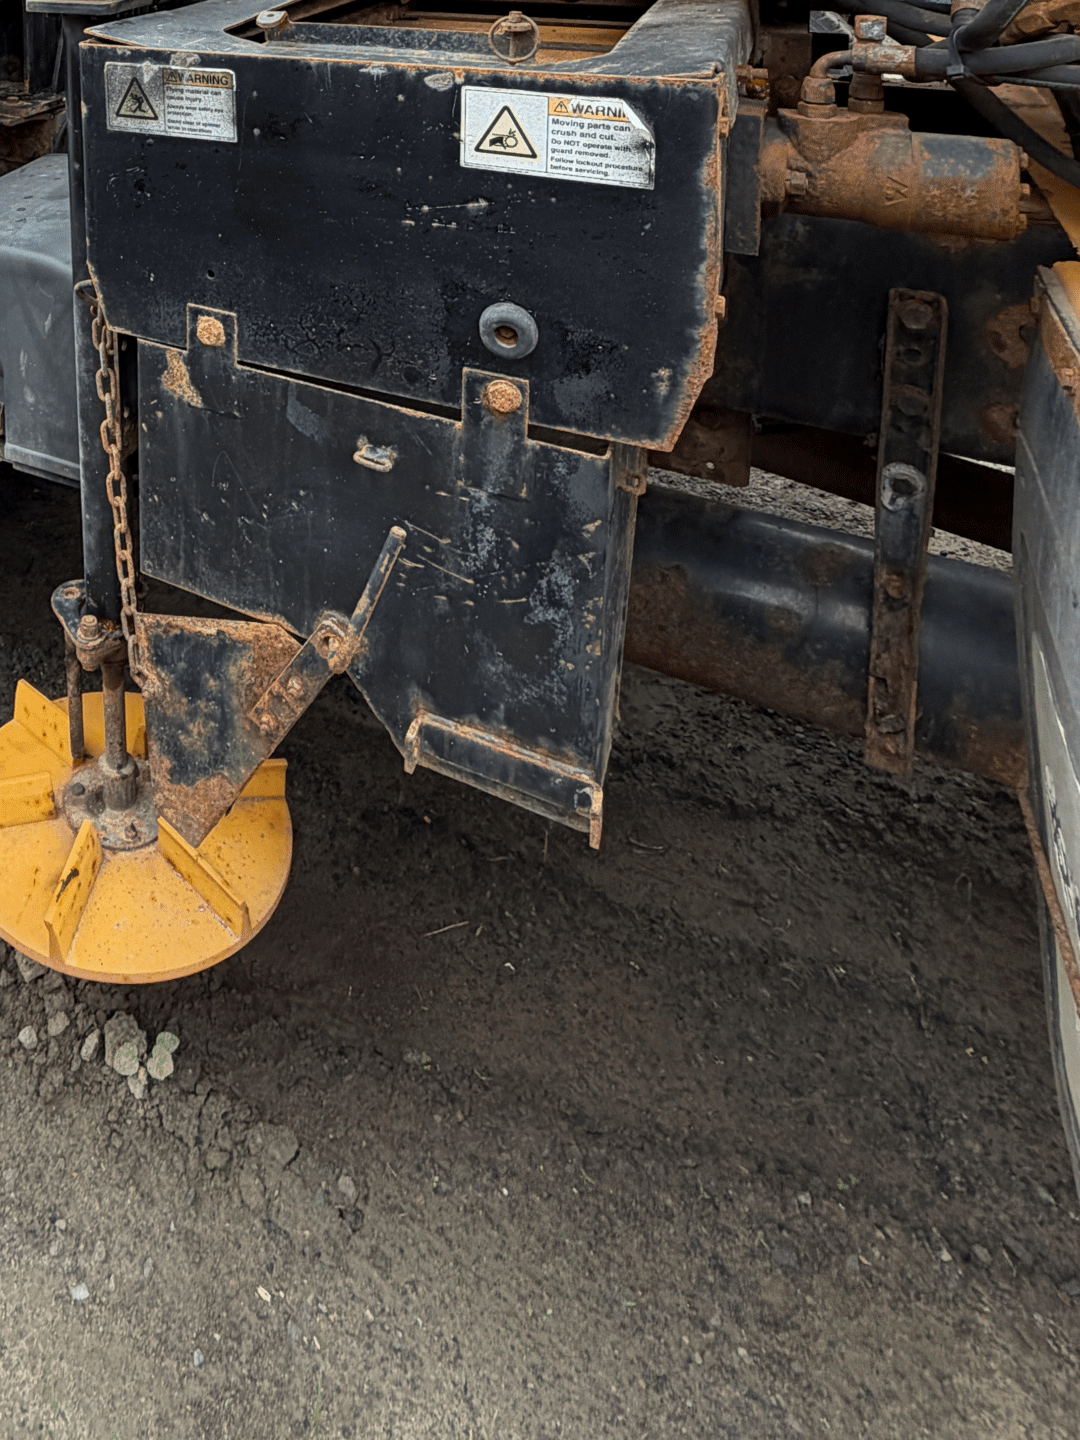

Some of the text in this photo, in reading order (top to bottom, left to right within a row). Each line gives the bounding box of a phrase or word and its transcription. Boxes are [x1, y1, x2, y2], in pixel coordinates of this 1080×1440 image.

[178, 73, 229, 85] WARNING
[571, 102, 626, 118] WARNI
[552, 118, 585, 129] Moving
[587, 122, 611, 131] parts
[551, 129, 617, 141] crush and cut.
[551, 147, 611, 159] guard removed.
[575, 167, 610, 177] servicing.
[605, 162, 643, 172] procedure
